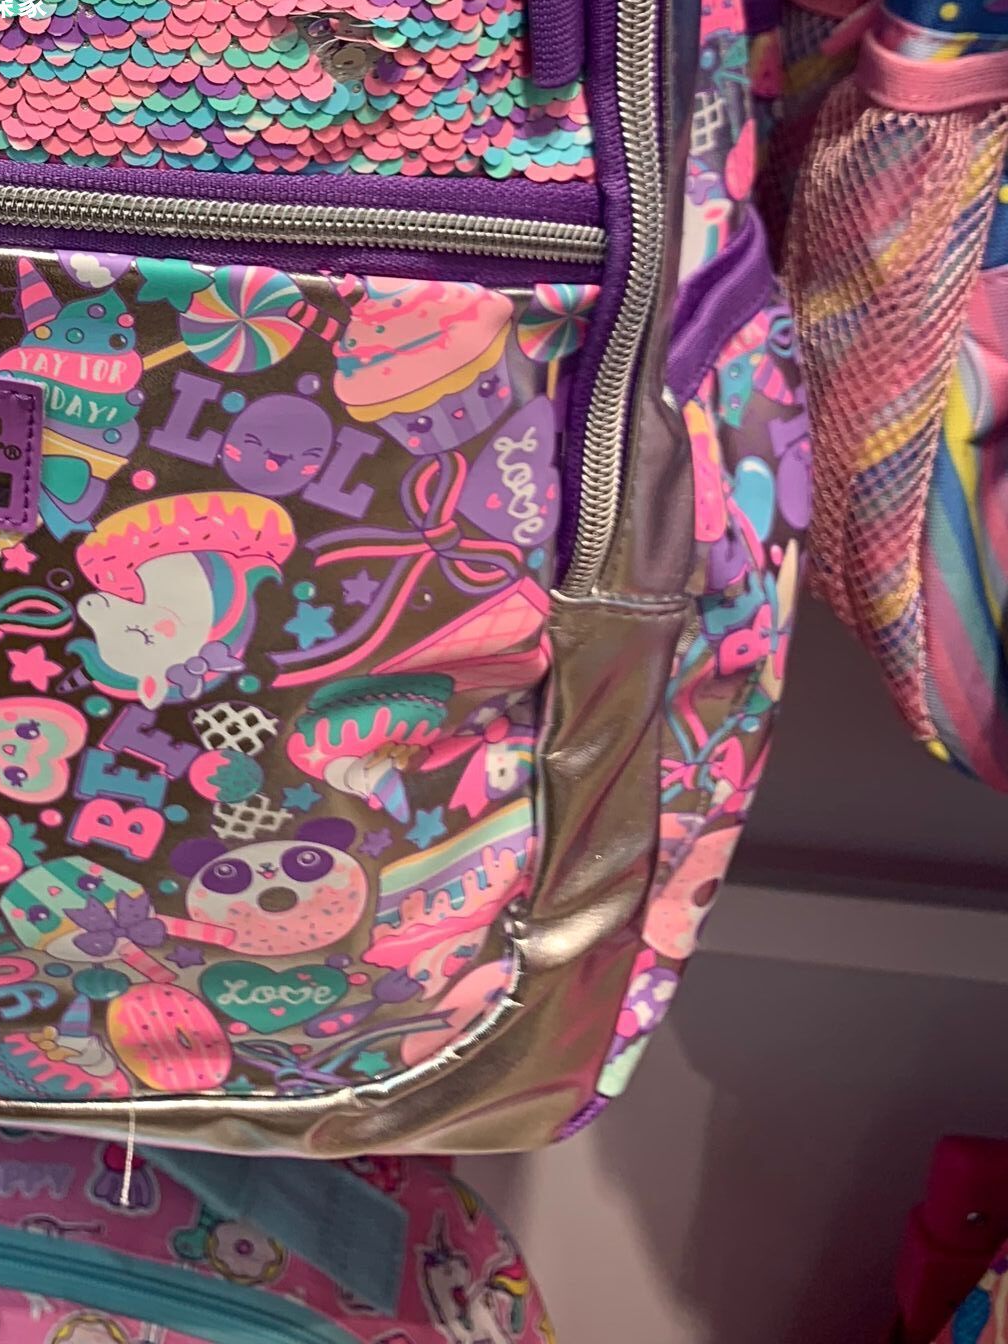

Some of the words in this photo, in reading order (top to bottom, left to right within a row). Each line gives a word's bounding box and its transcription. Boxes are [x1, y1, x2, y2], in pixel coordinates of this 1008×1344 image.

[18, 349, 69, 377] YAY
[78, 354, 128, 384] FOR
[216, 978, 337, 1006] Love
